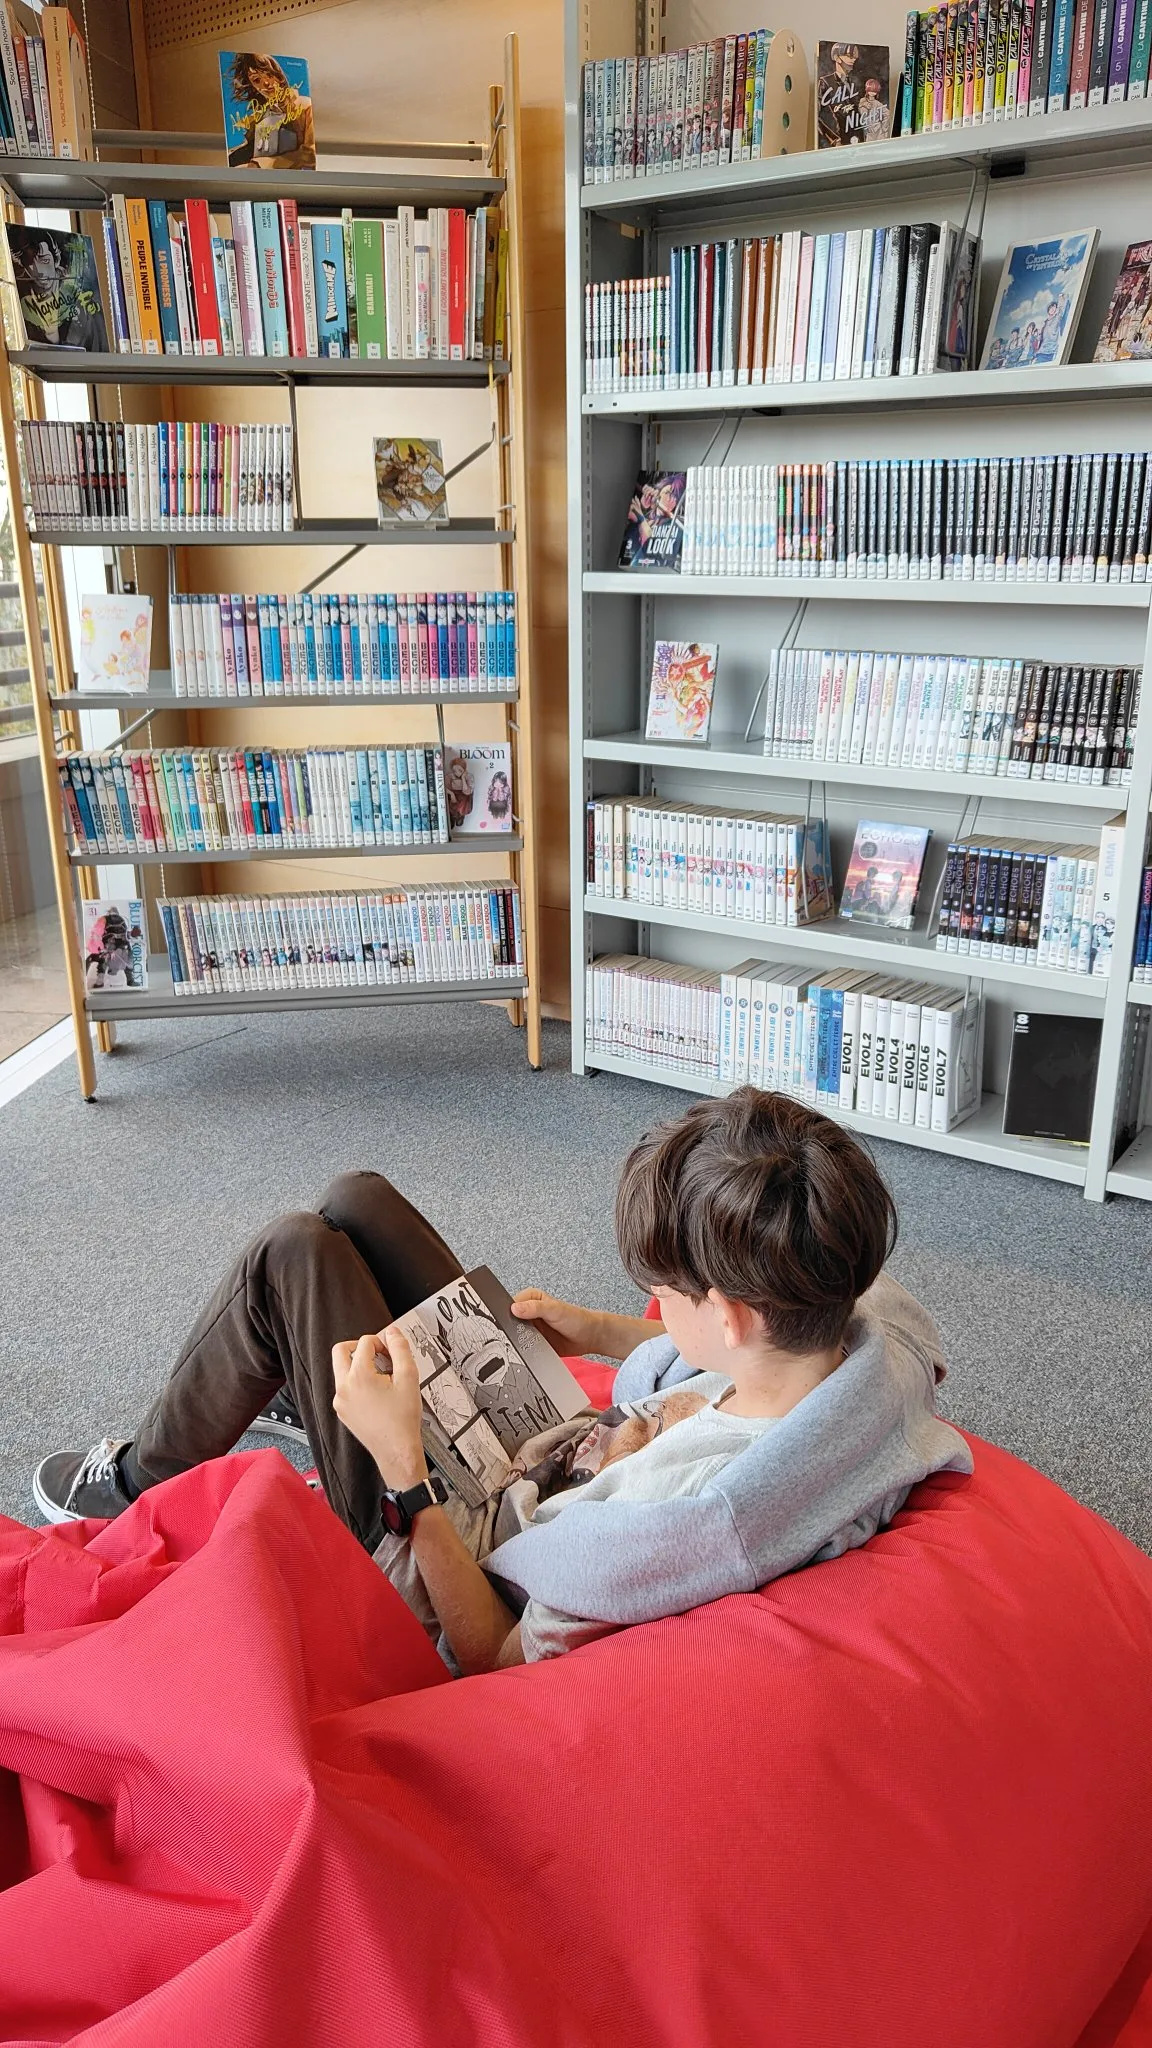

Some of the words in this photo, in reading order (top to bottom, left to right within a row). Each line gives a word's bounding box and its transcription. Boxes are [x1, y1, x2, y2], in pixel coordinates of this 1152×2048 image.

[821, 83, 859, 106] CALL
[845, 103, 887, 133] NIGHT
[137, 240, 145, 266] PEUPLE
[140, 268, 151, 311] INVISIBLE
[159, 263, 172, 309] PROMESSE
[626, 540, 632, 549] 3
[646, 538, 676, 554] LOOK
[401, 642, 409, 674] BECK
[459, 748, 505, 760] BLOOM
[131, 803, 142, 834] BECK
[1103, 892, 1110, 901] 5
[1017, 1014, 1029, 1025] 8
